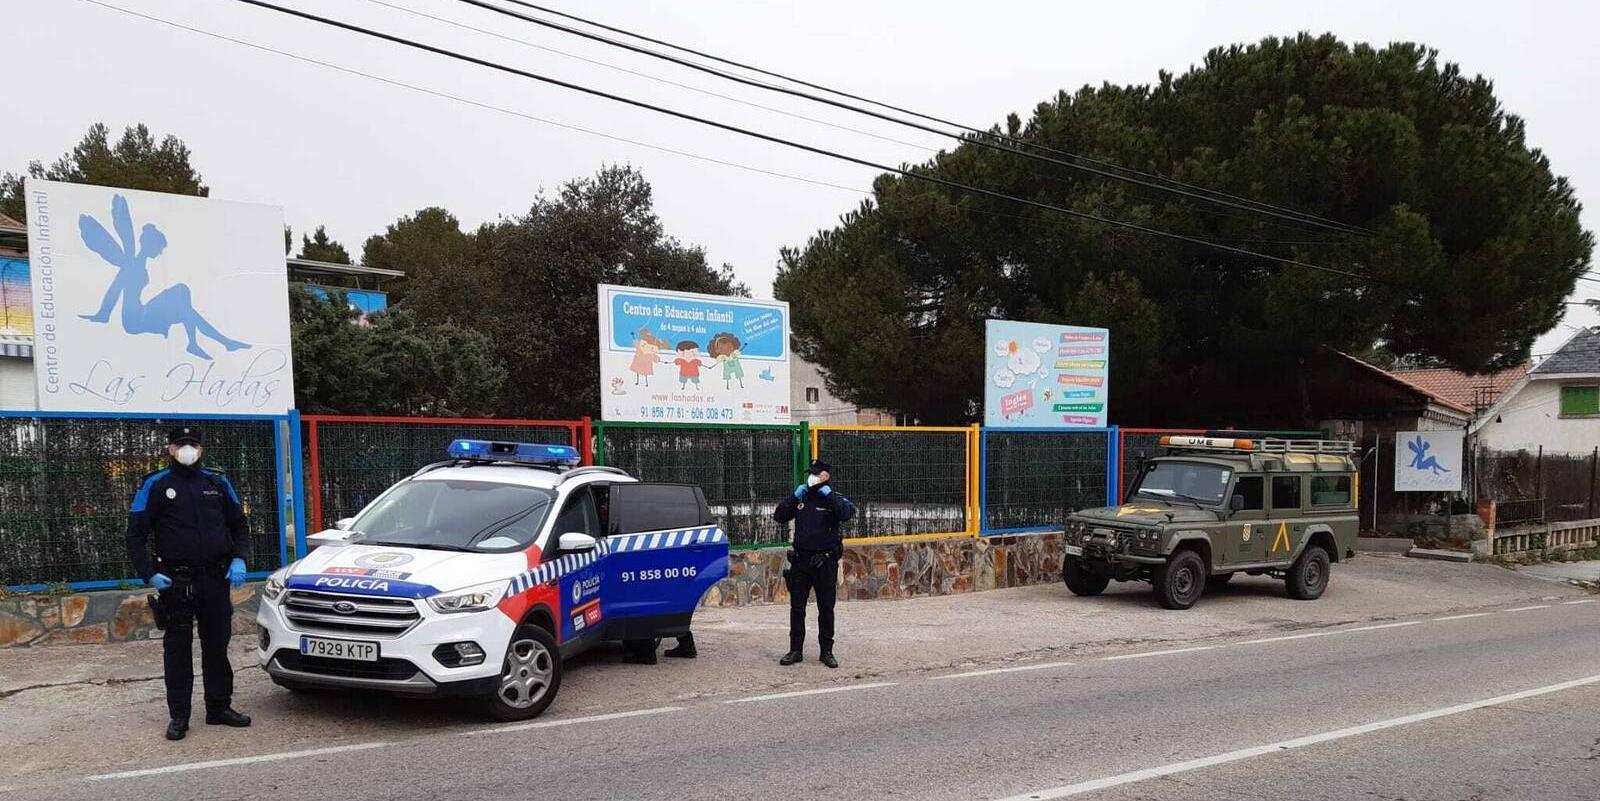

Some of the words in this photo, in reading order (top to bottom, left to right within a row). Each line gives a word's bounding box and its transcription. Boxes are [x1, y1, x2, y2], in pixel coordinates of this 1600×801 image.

[33, 190, 49, 241] Infantil
[39, 246, 54, 318] Educación
[623, 301, 651, 316] Centro
[653, 304, 663, 317] de
[664, 305, 705, 321] Educación
[706, 309, 734, 323] Infantil
[42, 323, 55, 341] de
[45, 346, 59, 393] Centro
[69, 360, 145, 405] Las
[161, 349, 287, 408] Hadas
[640, 405, 649, 418] 91
[666, 406, 675, 418] 77
[721, 407, 734, 420] 473
[1188, 438, 1214, 446] UME
[621, 571, 636, 582] 91
[640, 569, 662, 580] 858
[664, 568, 680, 579] 00
[682, 566, 697, 577] 06
[315, 577, 389, 592] POLICÍA
[309, 640, 343, 656] 7929
[347, 644, 373, 659] KTP
